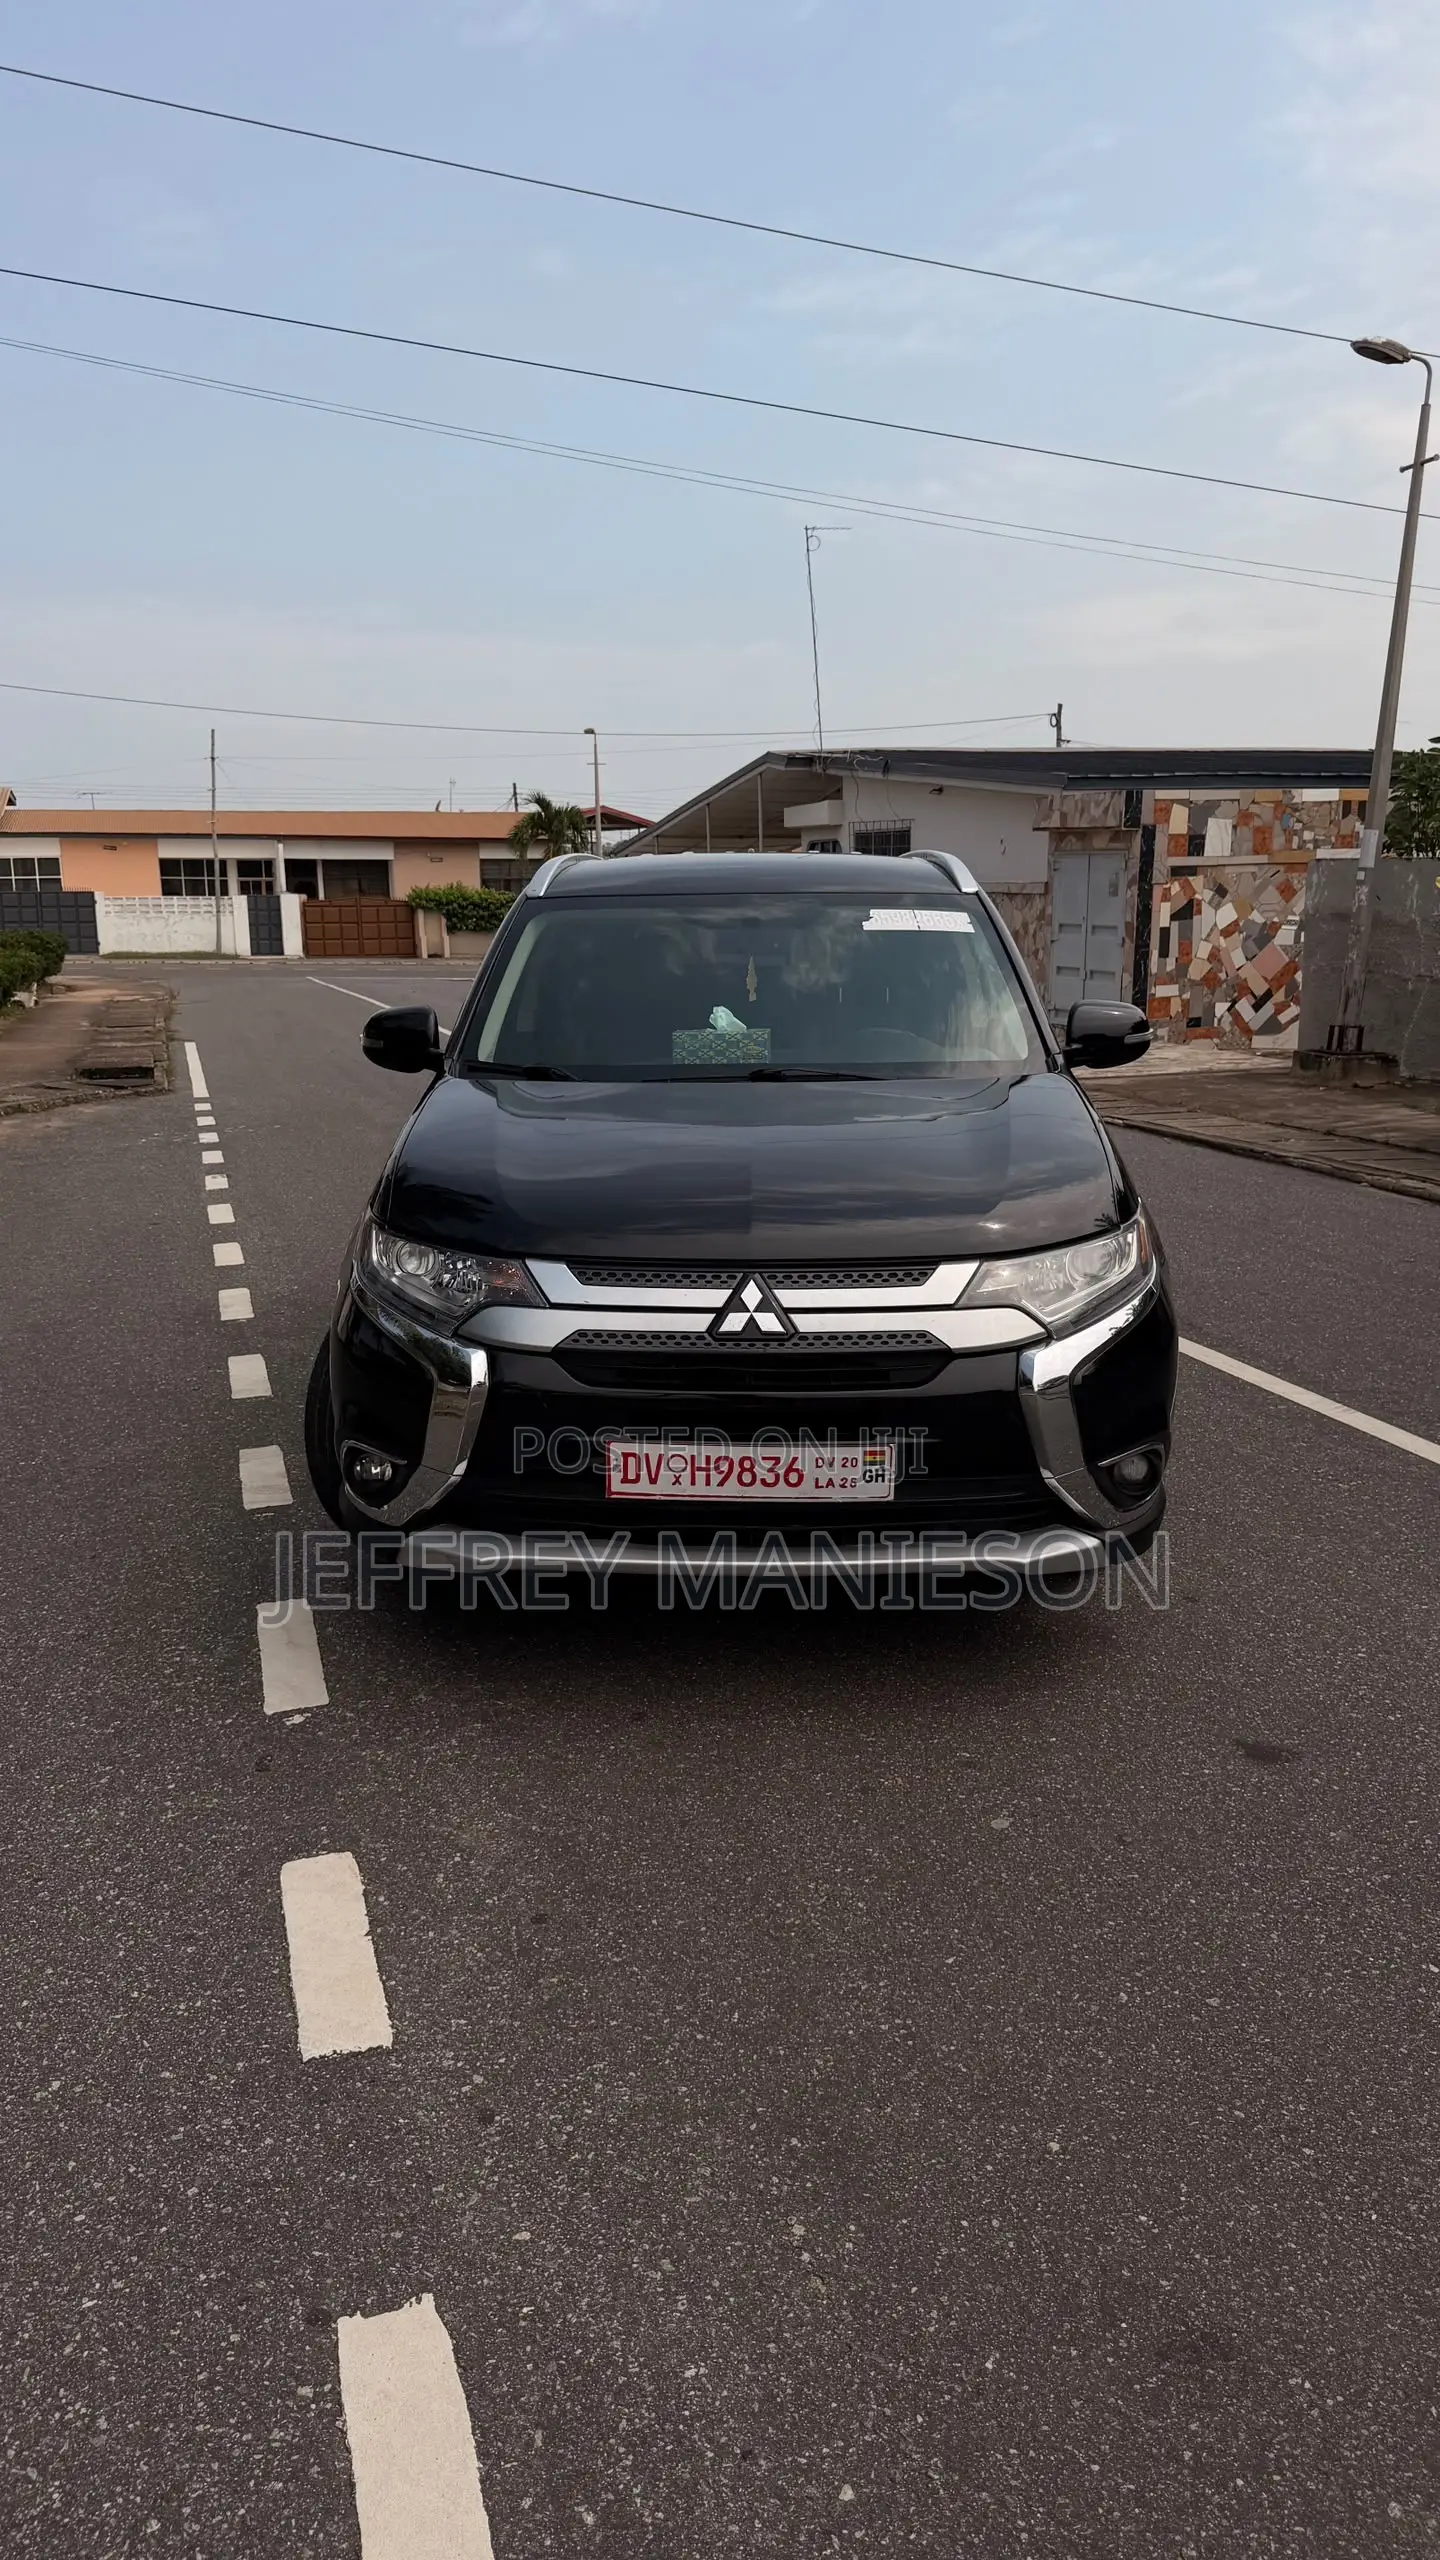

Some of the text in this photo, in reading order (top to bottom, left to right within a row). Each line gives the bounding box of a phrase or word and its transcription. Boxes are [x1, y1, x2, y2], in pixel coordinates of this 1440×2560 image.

[815, 1456, 858, 1468] DV 20
[620, 1451, 665, 1485] DV
[690, 1454, 805, 1488] H9836
[862, 1468, 886, 1484] GH
[814, 1477, 836, 1489] LA
